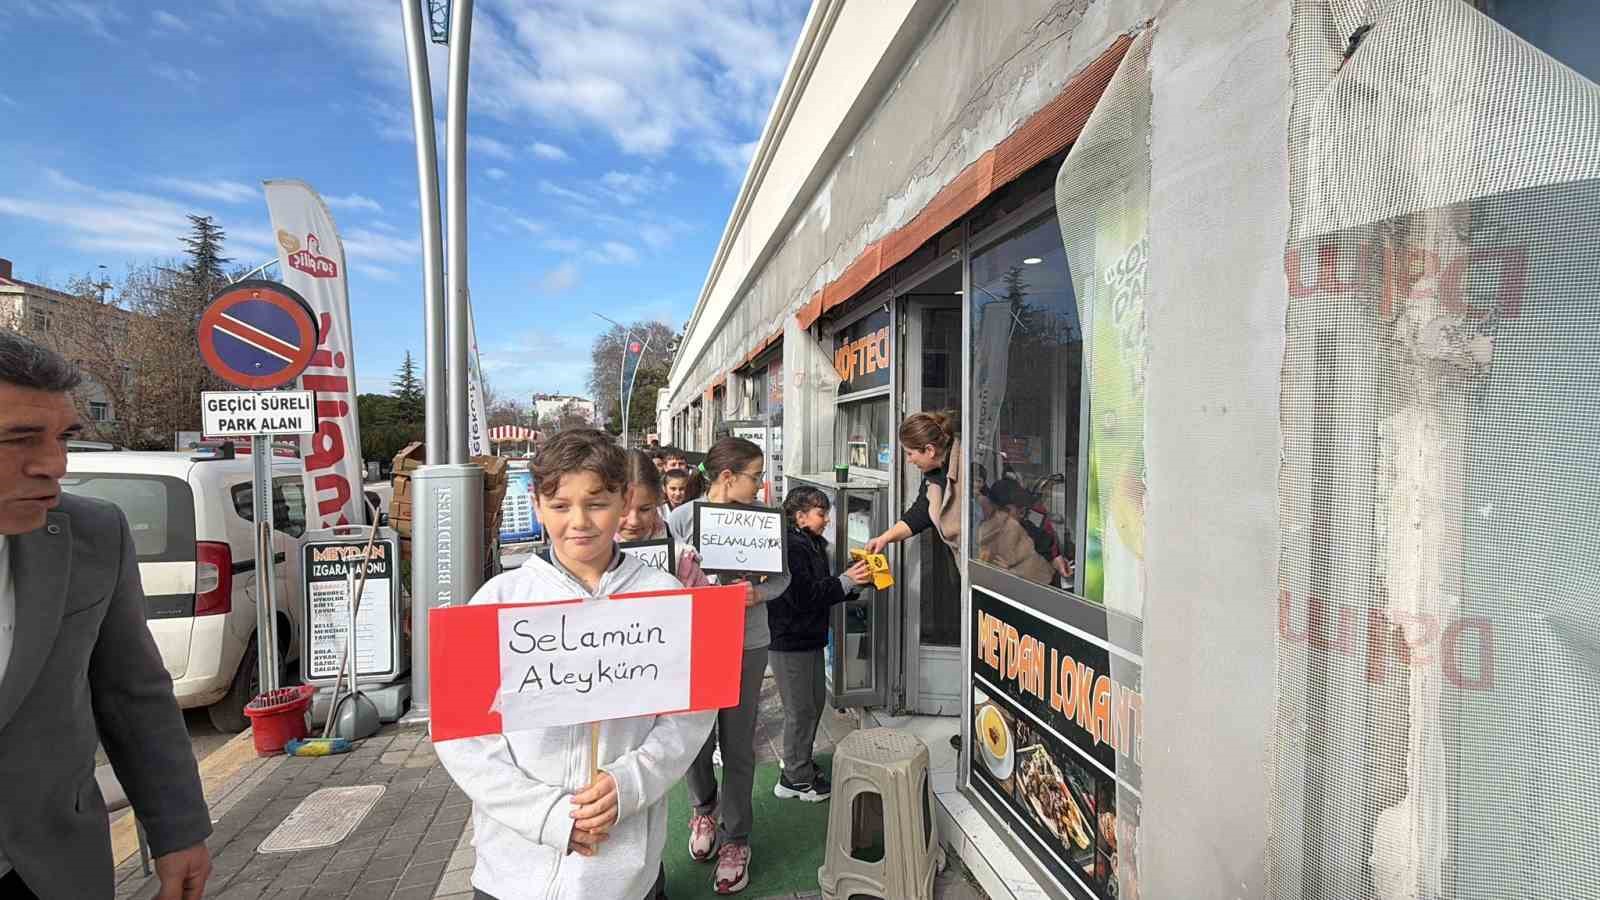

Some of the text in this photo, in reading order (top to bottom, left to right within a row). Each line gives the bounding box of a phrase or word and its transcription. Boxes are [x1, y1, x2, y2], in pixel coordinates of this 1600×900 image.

[208, 395, 309, 414] GEÇİCİ SÜRELİ
[218, 417, 302, 431] PARK ALANI
[313, 545, 385, 562] MEYDAN
[313, 564, 347, 577] IZGARA
[509, 615, 666, 654] Selamün
[977, 608, 1046, 701] MEYDAN
[518, 659, 658, 693] Aleyküm
